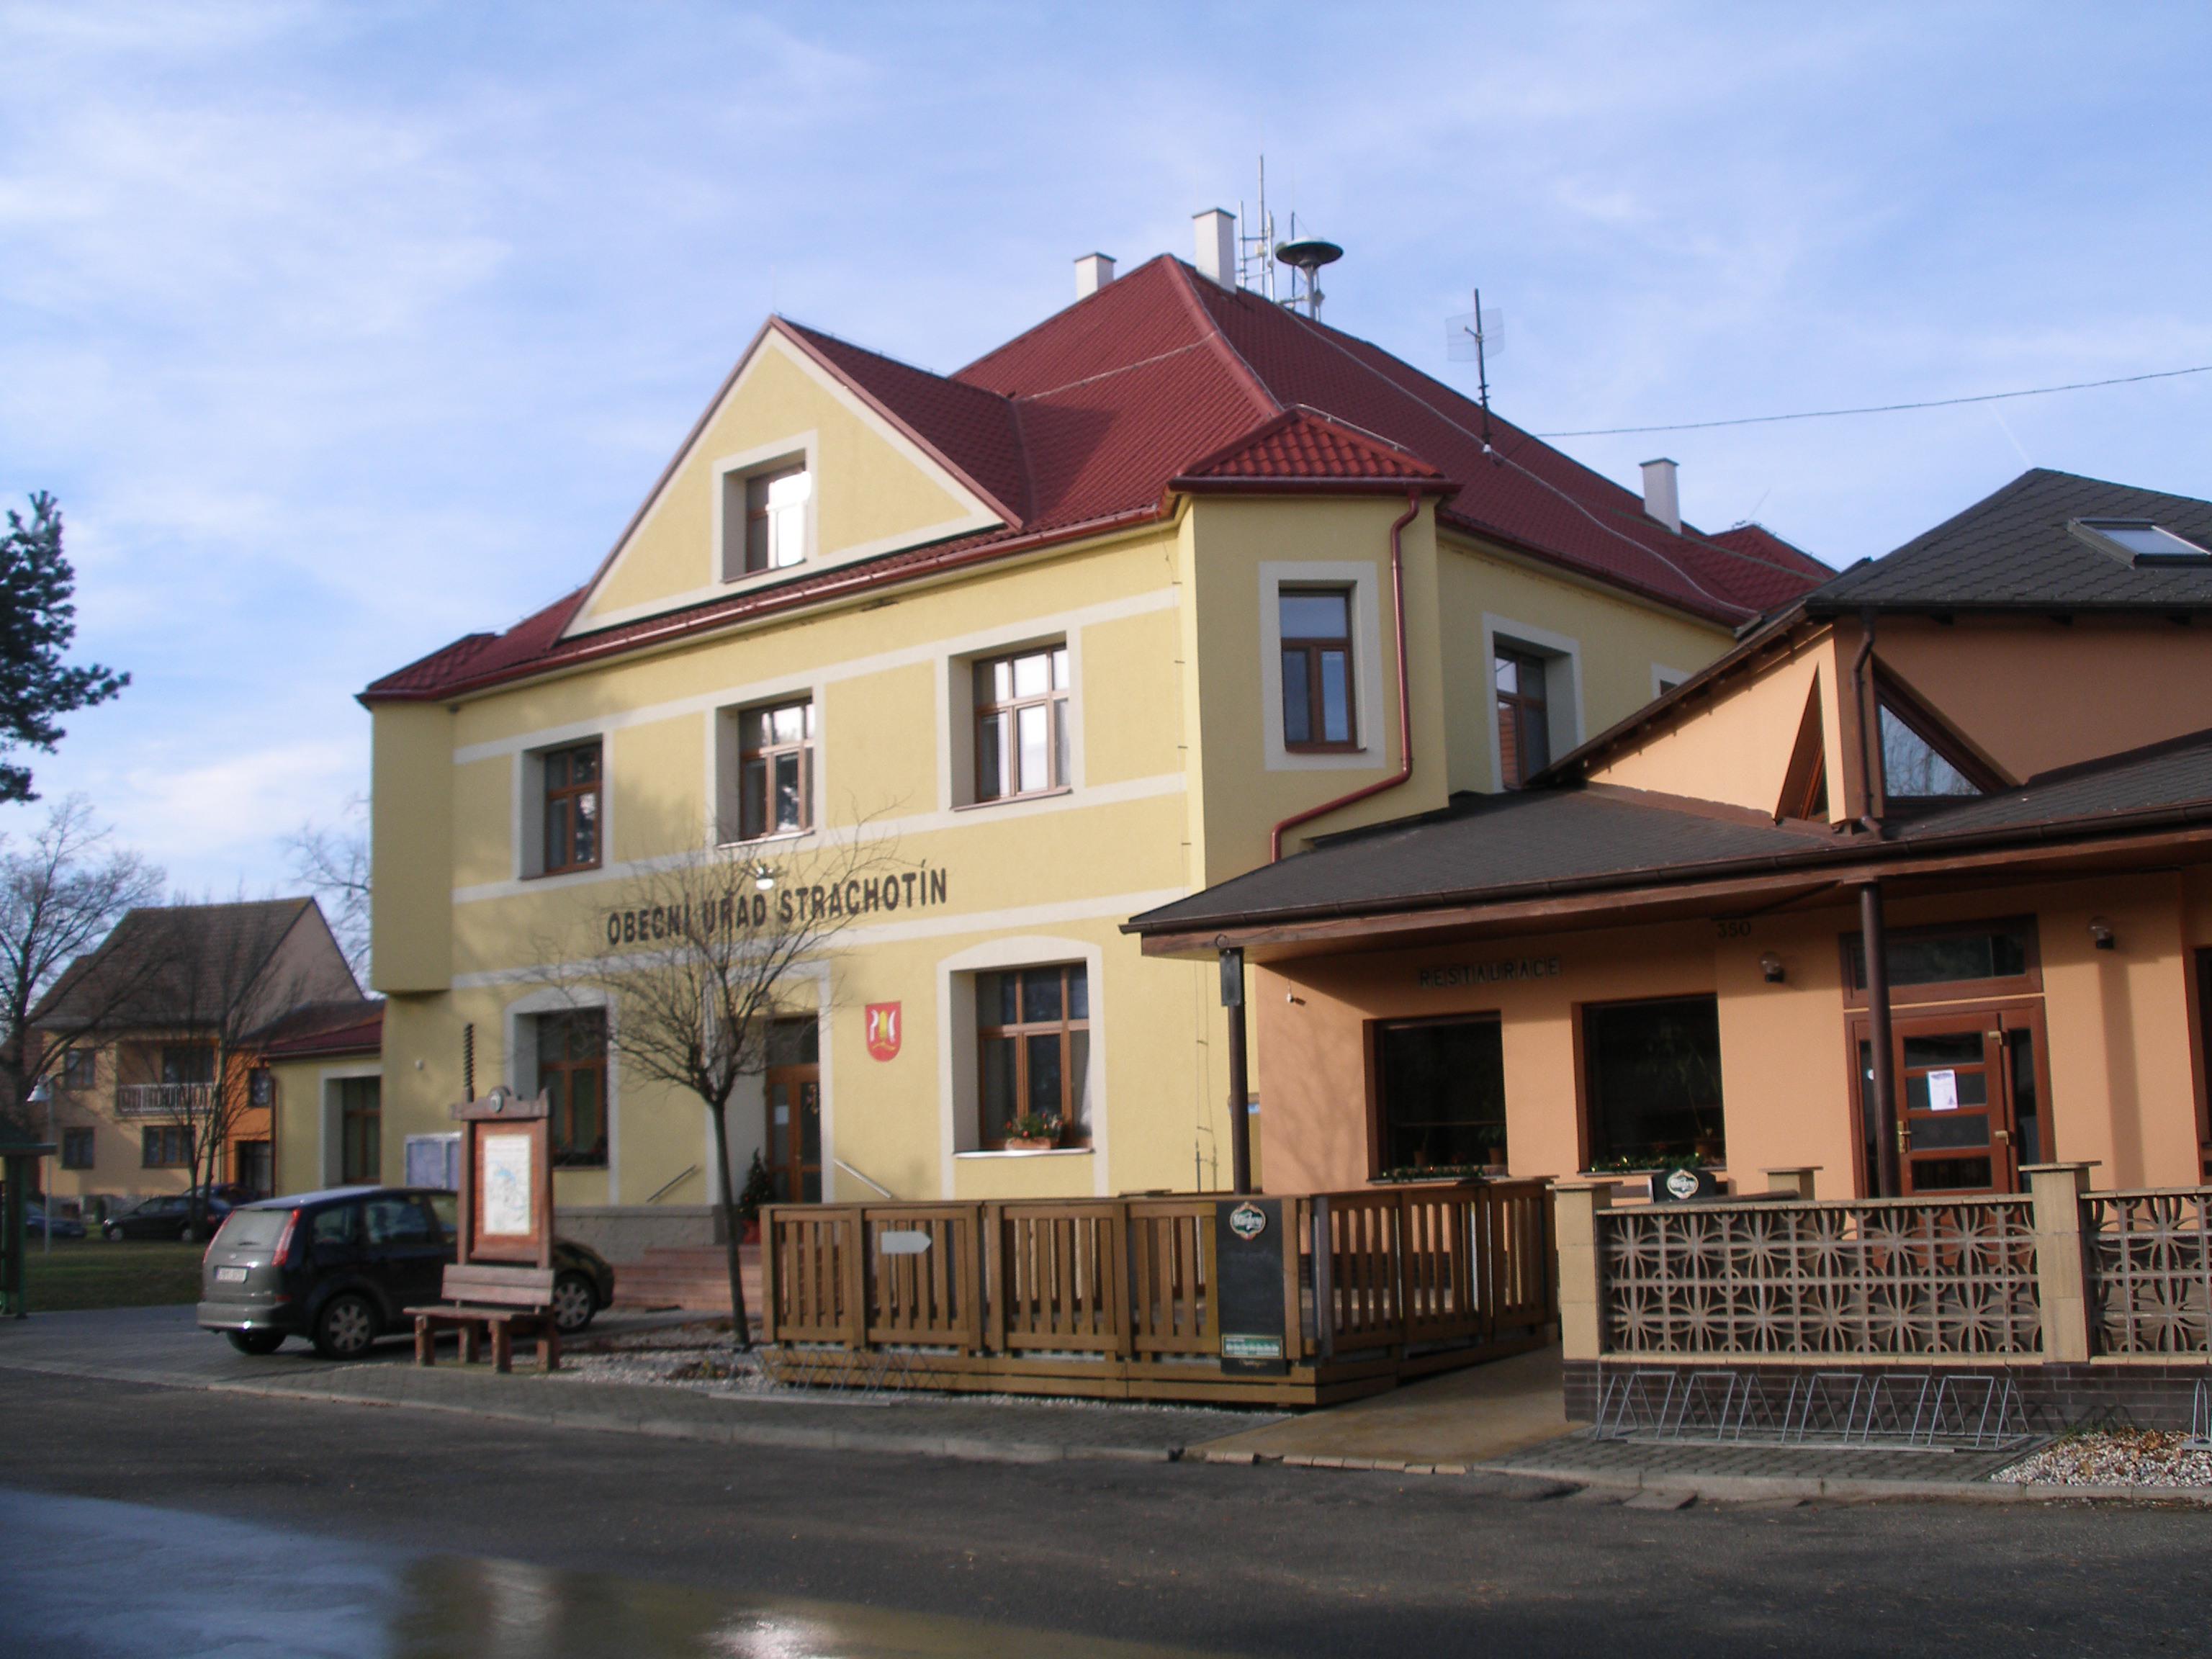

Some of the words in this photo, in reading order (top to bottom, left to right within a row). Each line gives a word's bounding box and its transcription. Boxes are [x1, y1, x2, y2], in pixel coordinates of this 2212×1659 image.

[608, 893, 690, 945] OBECNÍ
[779, 859, 947, 924] STRACHOTÍN
[1717, 921, 1751, 938] 350
[1419, 956, 1559, 986] RESTAURACE
